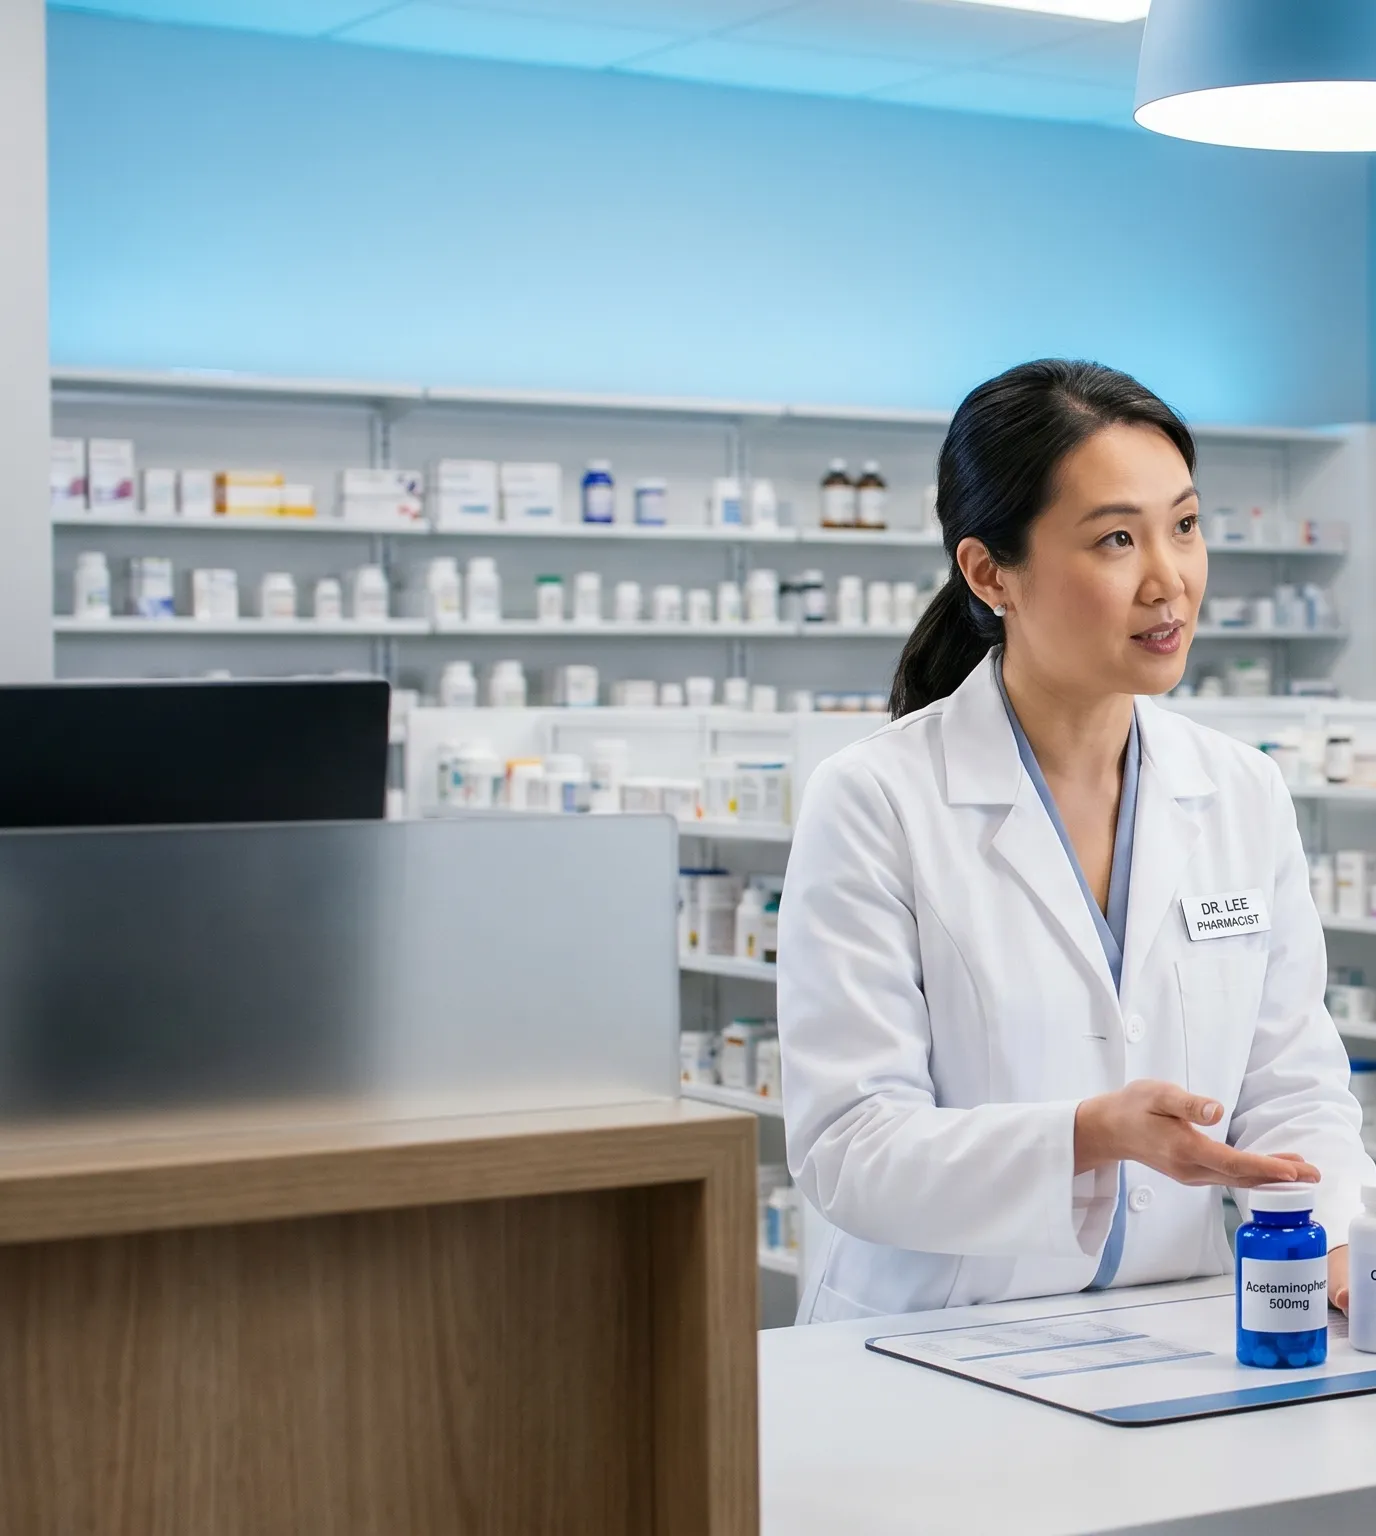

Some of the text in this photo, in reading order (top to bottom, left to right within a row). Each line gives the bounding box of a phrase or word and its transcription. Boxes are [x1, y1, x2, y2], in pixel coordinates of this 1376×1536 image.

[1201, 898, 1249, 915] DR. LEE
[1197, 914, 1259, 931] PHARMACIST
[1269, 1298, 1310, 1311] 500mg
